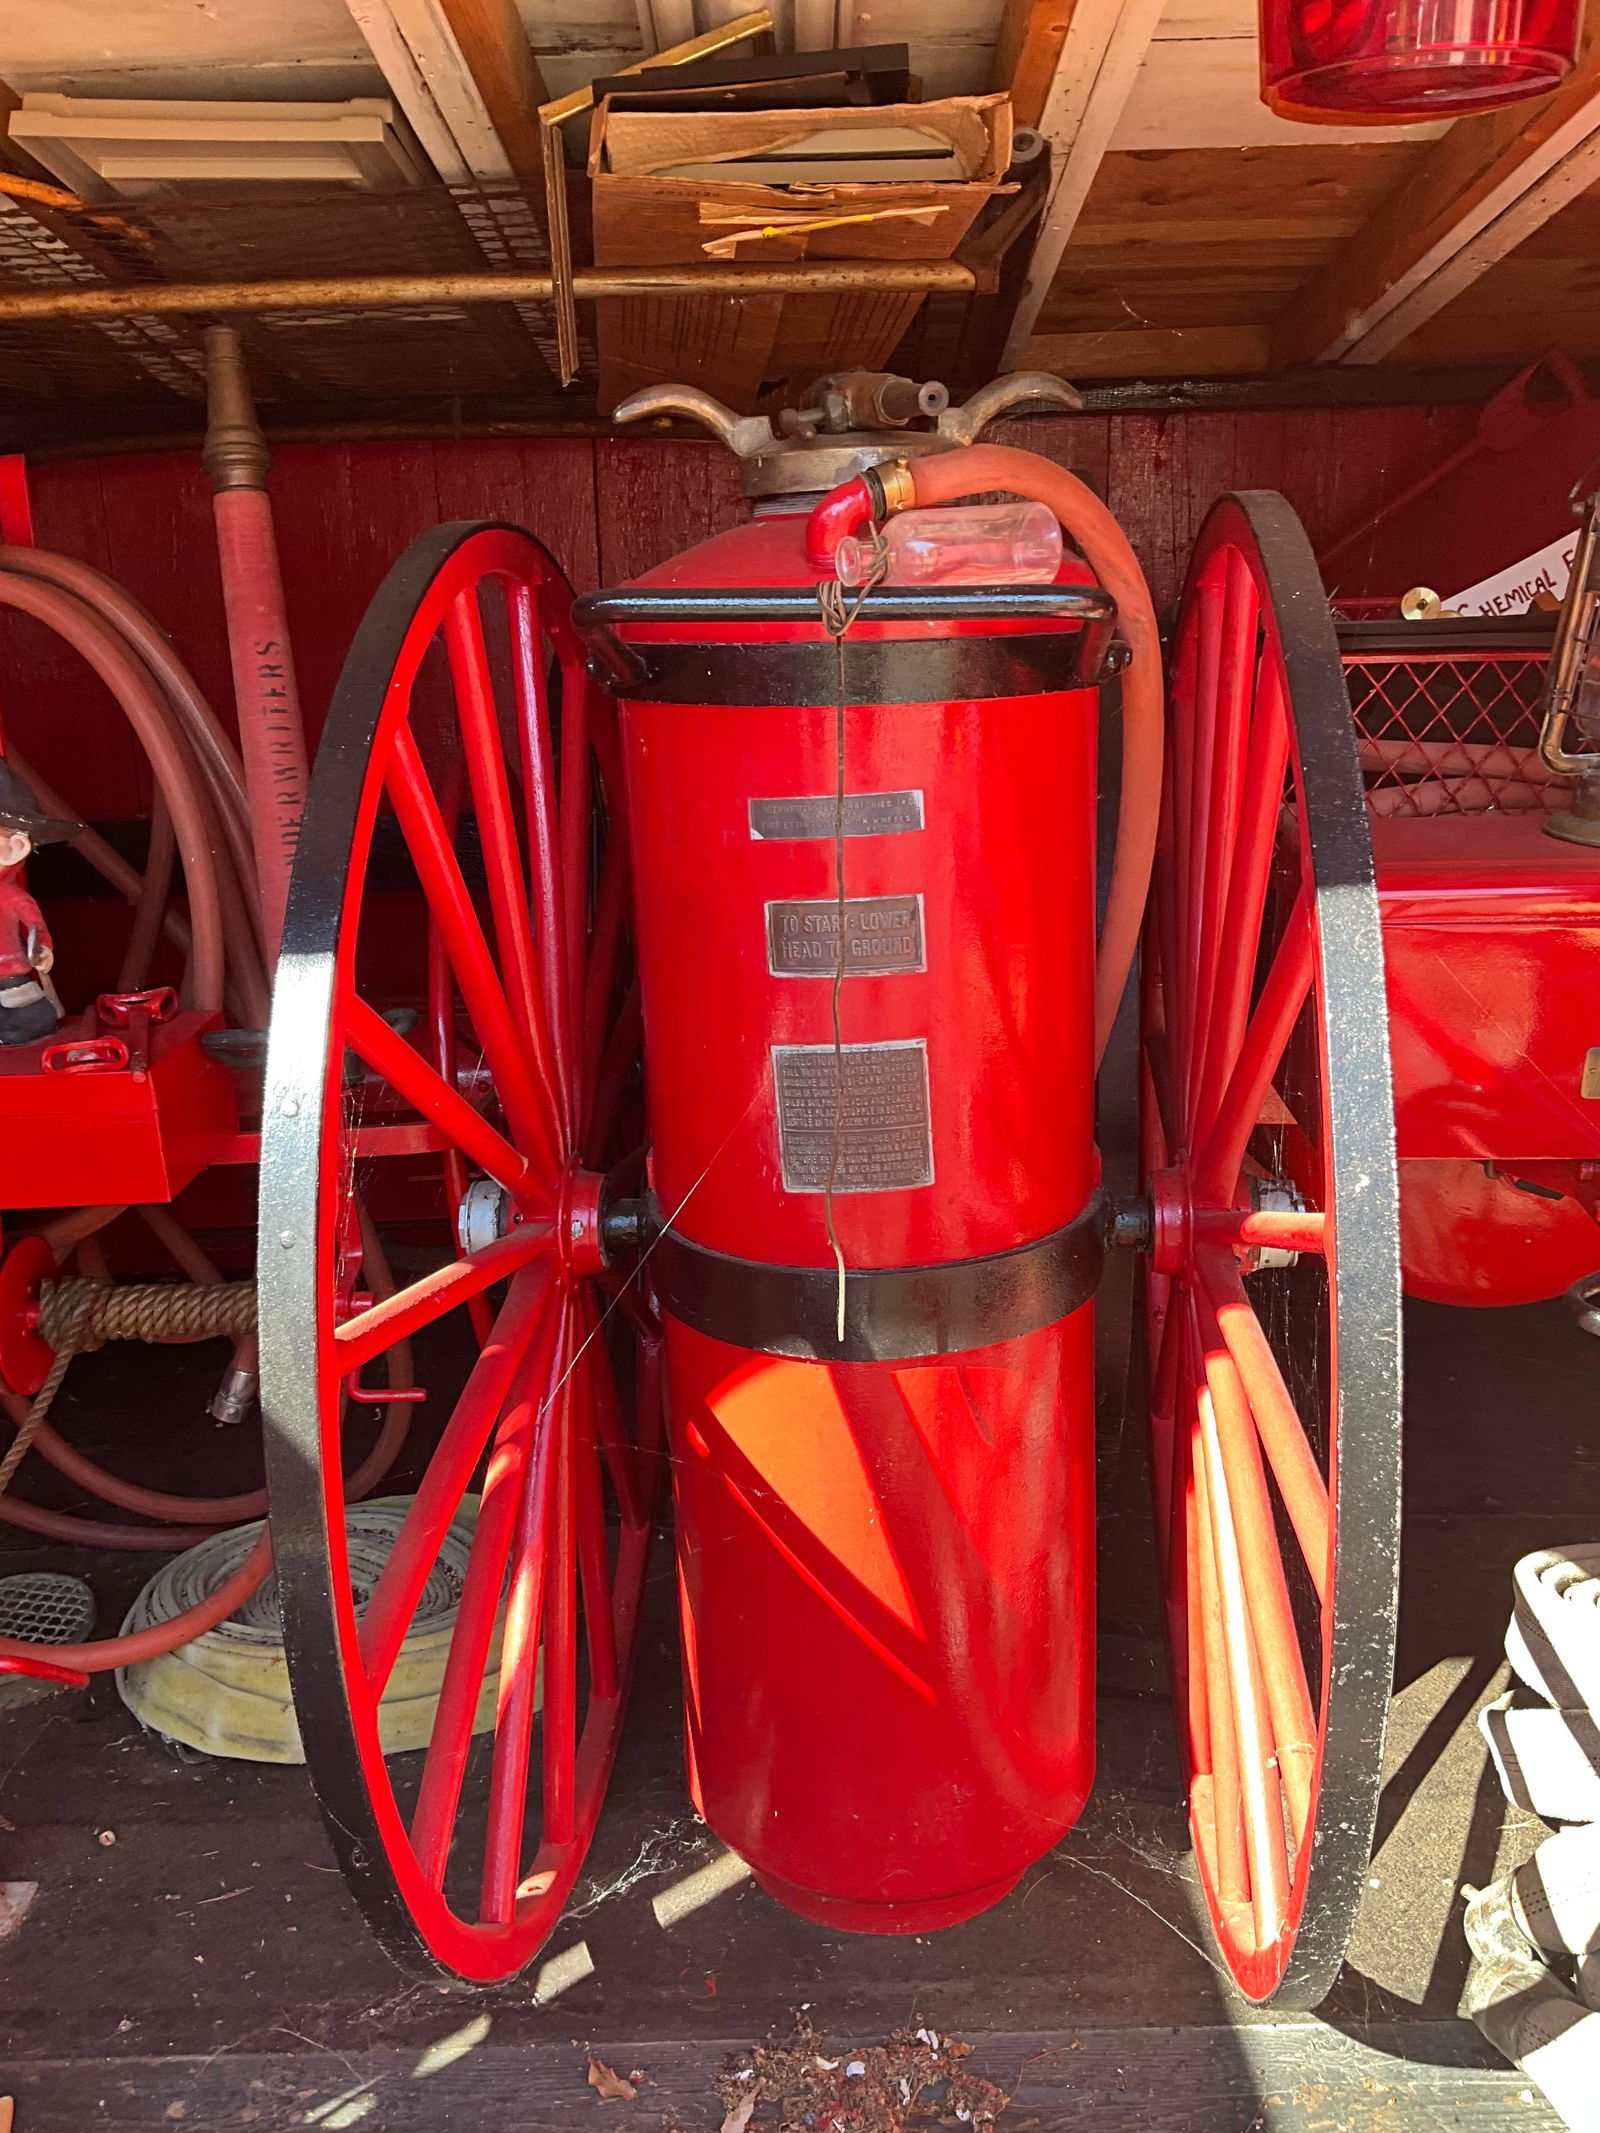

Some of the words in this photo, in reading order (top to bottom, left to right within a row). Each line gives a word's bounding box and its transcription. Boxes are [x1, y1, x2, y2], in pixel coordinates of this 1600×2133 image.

[255, 640, 303, 878] NDERWRITERS
[823, 800, 893, 812] LAORATORIES
[784, 818, 849, 829] EXTINGUISHR
[780, 914, 799, 934] TO
[804, 914, 855, 933] START:
[860, 910, 912, 931] LOWER
[782, 940, 822, 960] HEAD
[852, 936, 914, 957] GROUND
[784, 1055, 838, 1067] DIRECTION
